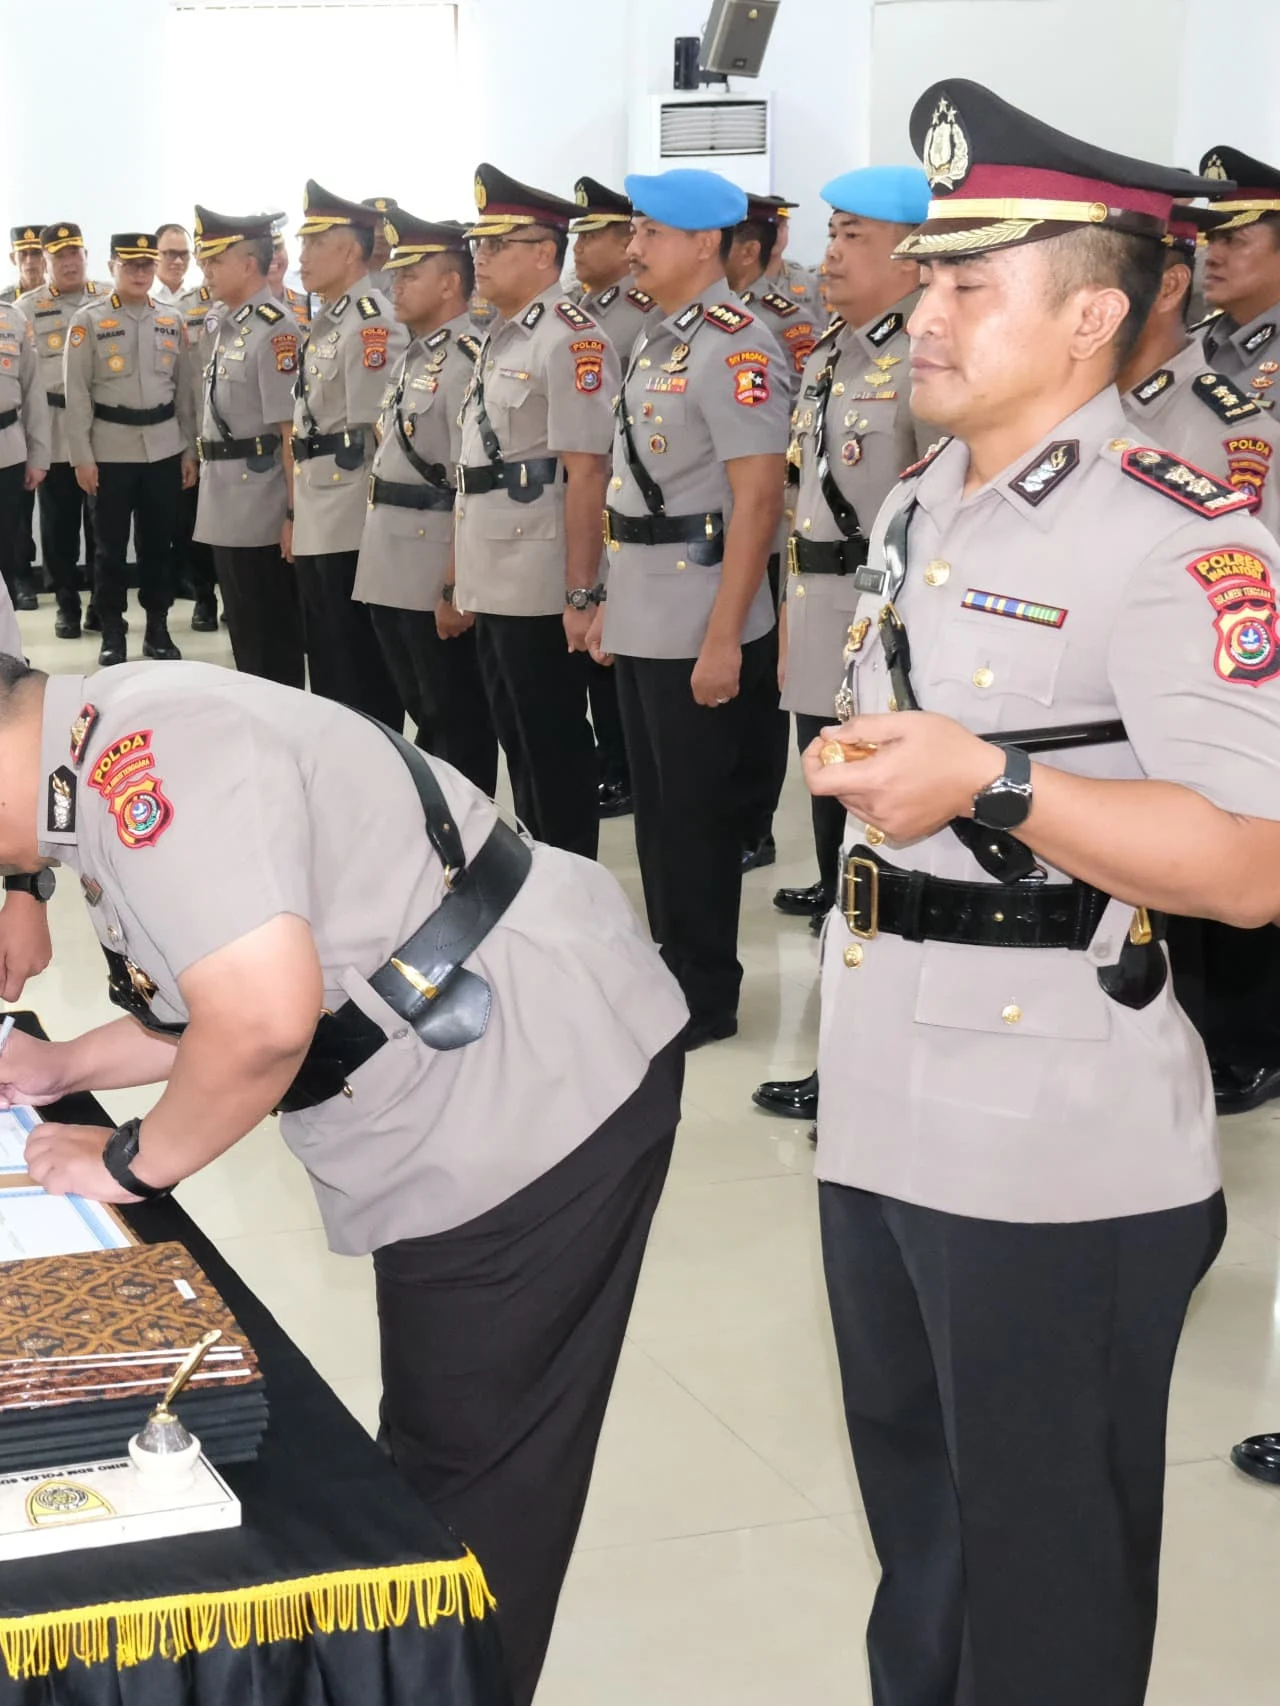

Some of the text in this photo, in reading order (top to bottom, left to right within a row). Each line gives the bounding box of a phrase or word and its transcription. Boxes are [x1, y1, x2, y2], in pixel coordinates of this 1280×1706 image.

[1228, 439, 1269, 457] POLDA
[1196, 552, 1264, 576] POLRES
[94, 734, 144, 784] POLDA
[22, 1471, 64, 1482] POLDA
[67, 1467, 95, 1476] SDM
